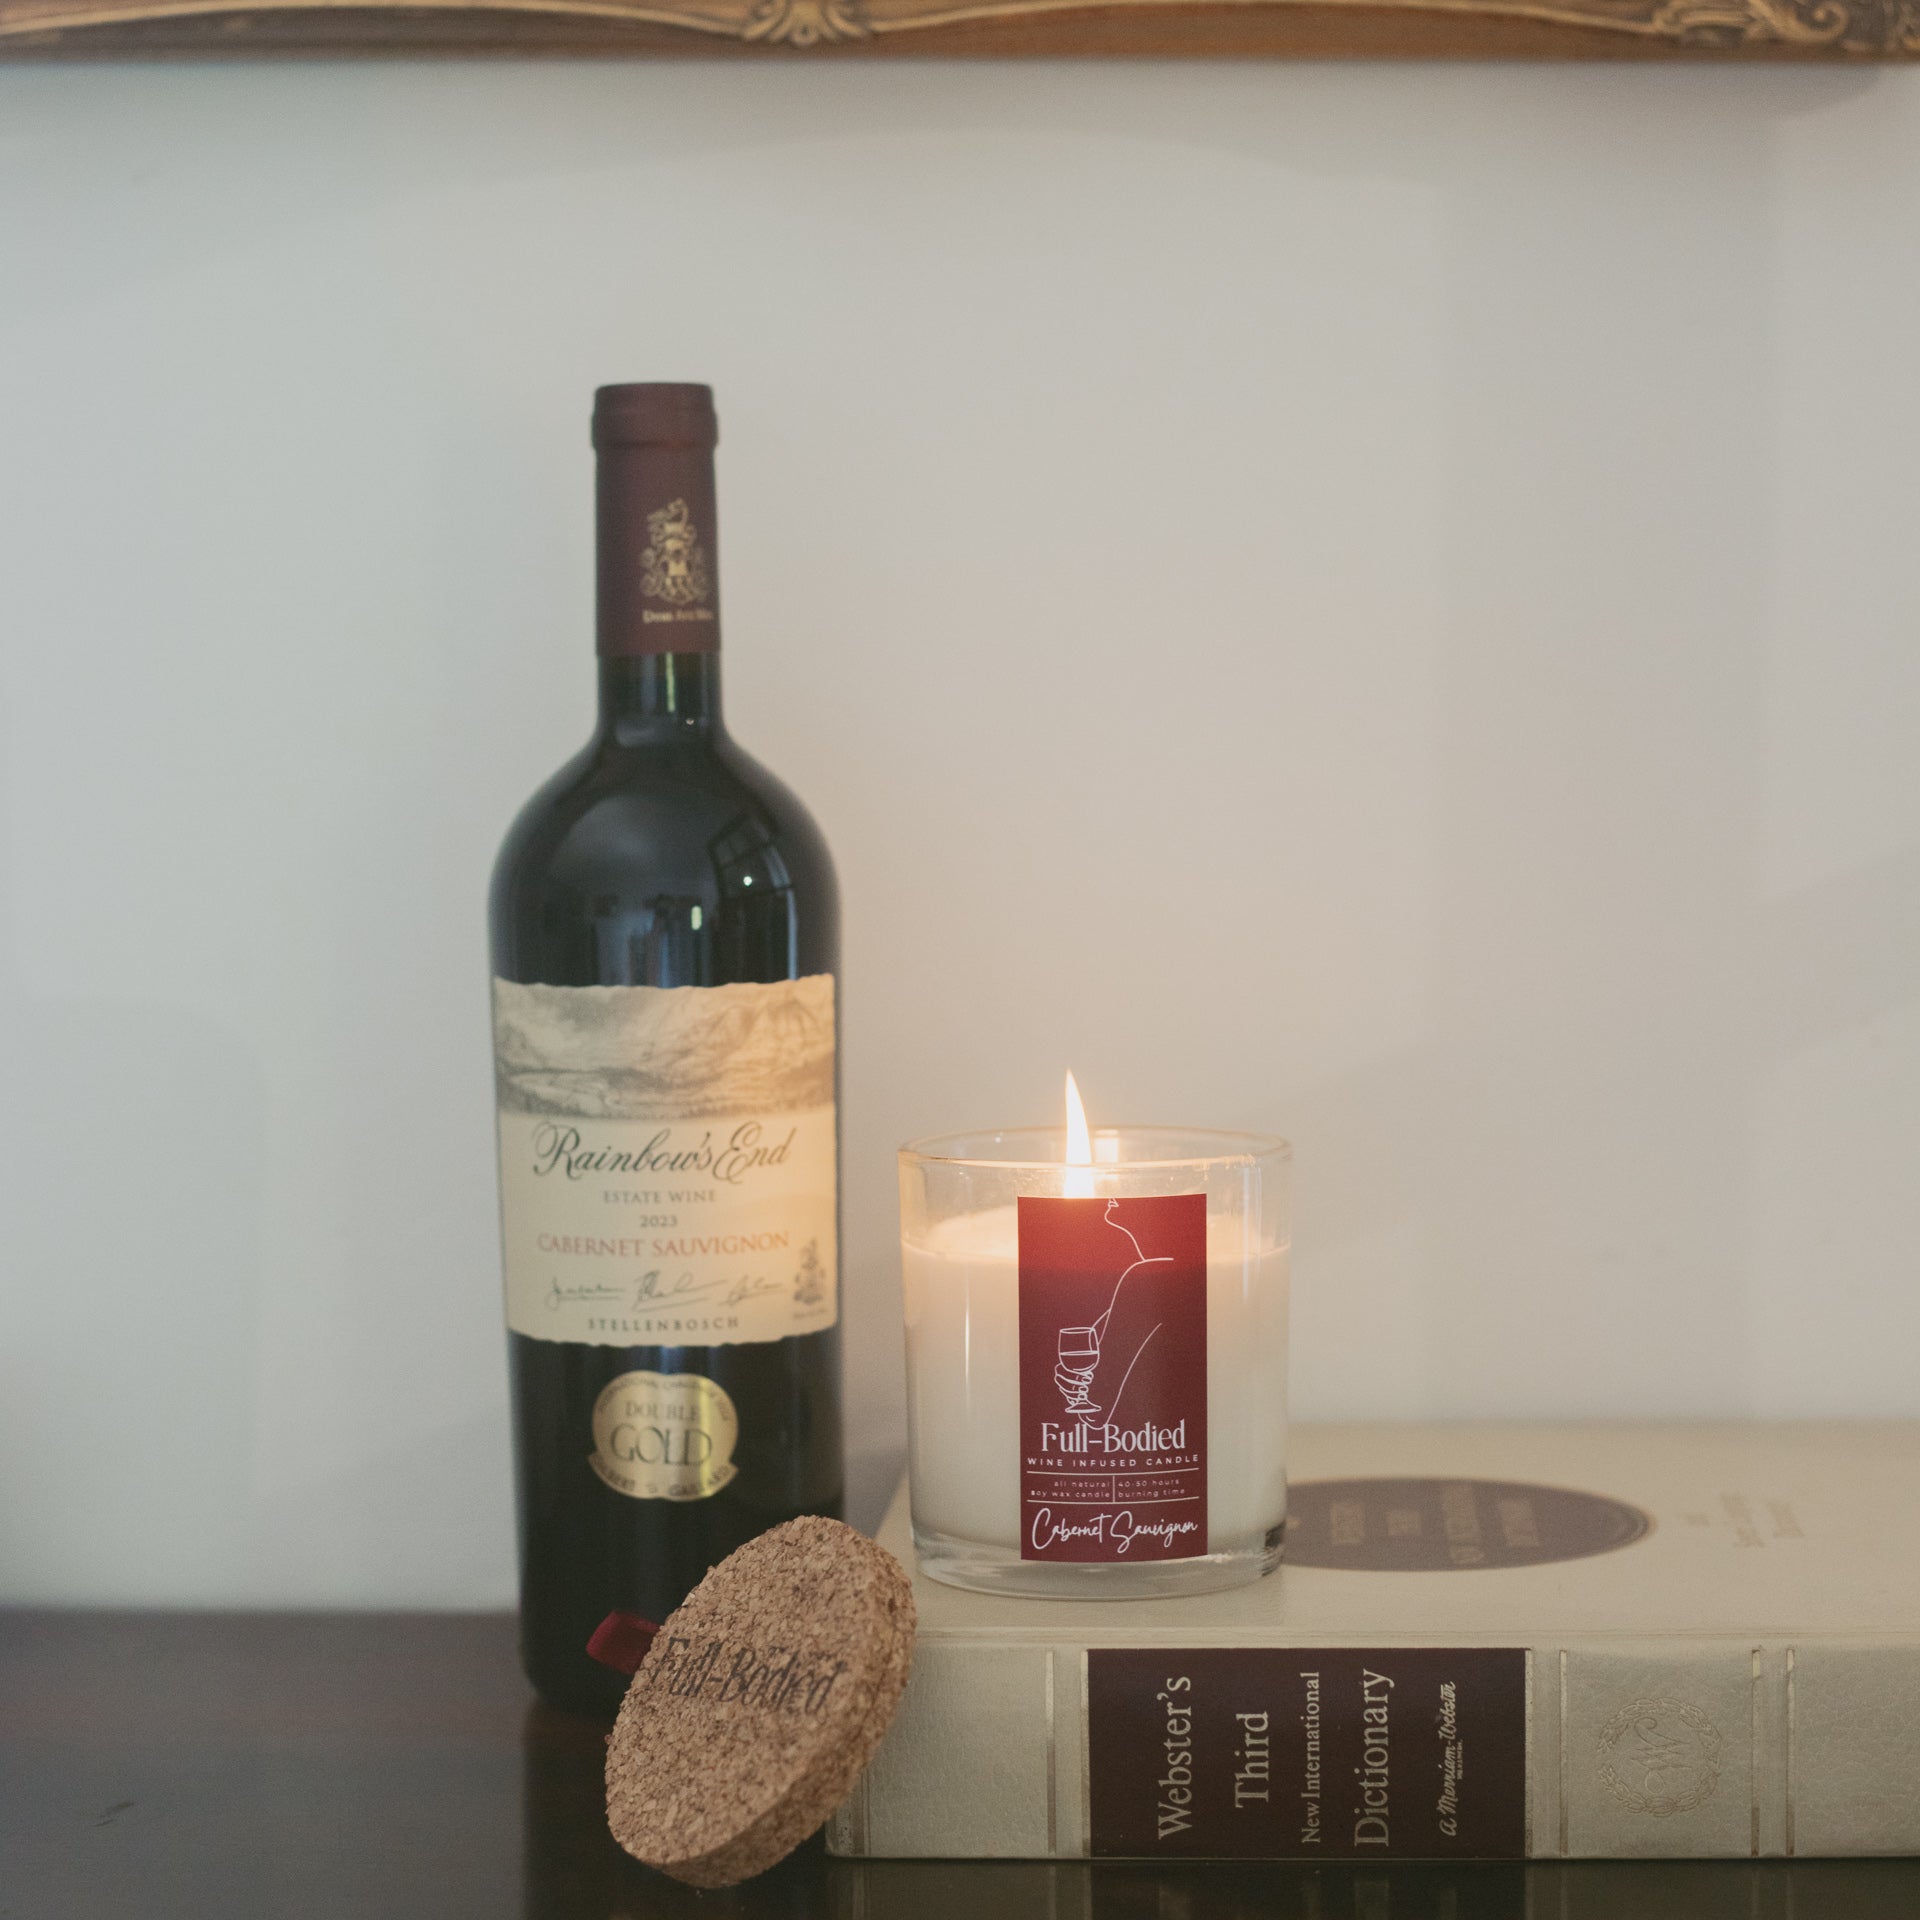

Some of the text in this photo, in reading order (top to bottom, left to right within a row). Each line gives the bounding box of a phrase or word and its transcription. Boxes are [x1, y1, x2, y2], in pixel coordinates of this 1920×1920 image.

[532, 1120, 797, 1184] Rainbow's End
[603, 1189, 717, 1204] ESTATE WINE
[639, 1214, 678, 1228] 2023
[536, 1230, 790, 1258] CABERNET SAUVIGNON
[588, 1317, 739, 1332] STELLENBOSCH
[611, 1423, 713, 1466] GOLD
[1041, 1418, 1186, 1453] Full-Bodied
[1027, 1454, 1199, 1468] WINE INFUSED CANDLE
[1030, 1490, 1047, 1498] soy
[1075, 1490, 1110, 1498] candle
[1054, 1480, 1110, 1488] all natural
[1118, 1488, 1185, 1499] burning time
[1152, 1478, 1180, 1487] hours
[1032, 1507, 1198, 1554] Cabernet Sauvignon
[650, 1636, 848, 1716] Full-Bodied
[1157, 1675, 1193, 1840] Webster's
[1234, 1711, 1269, 1808] Third
[1300, 1671, 1320, 1844] New International
[1353, 1668, 1395, 1848] Dictionary
[1435, 1680, 1458, 1815] Merriam-Webster
